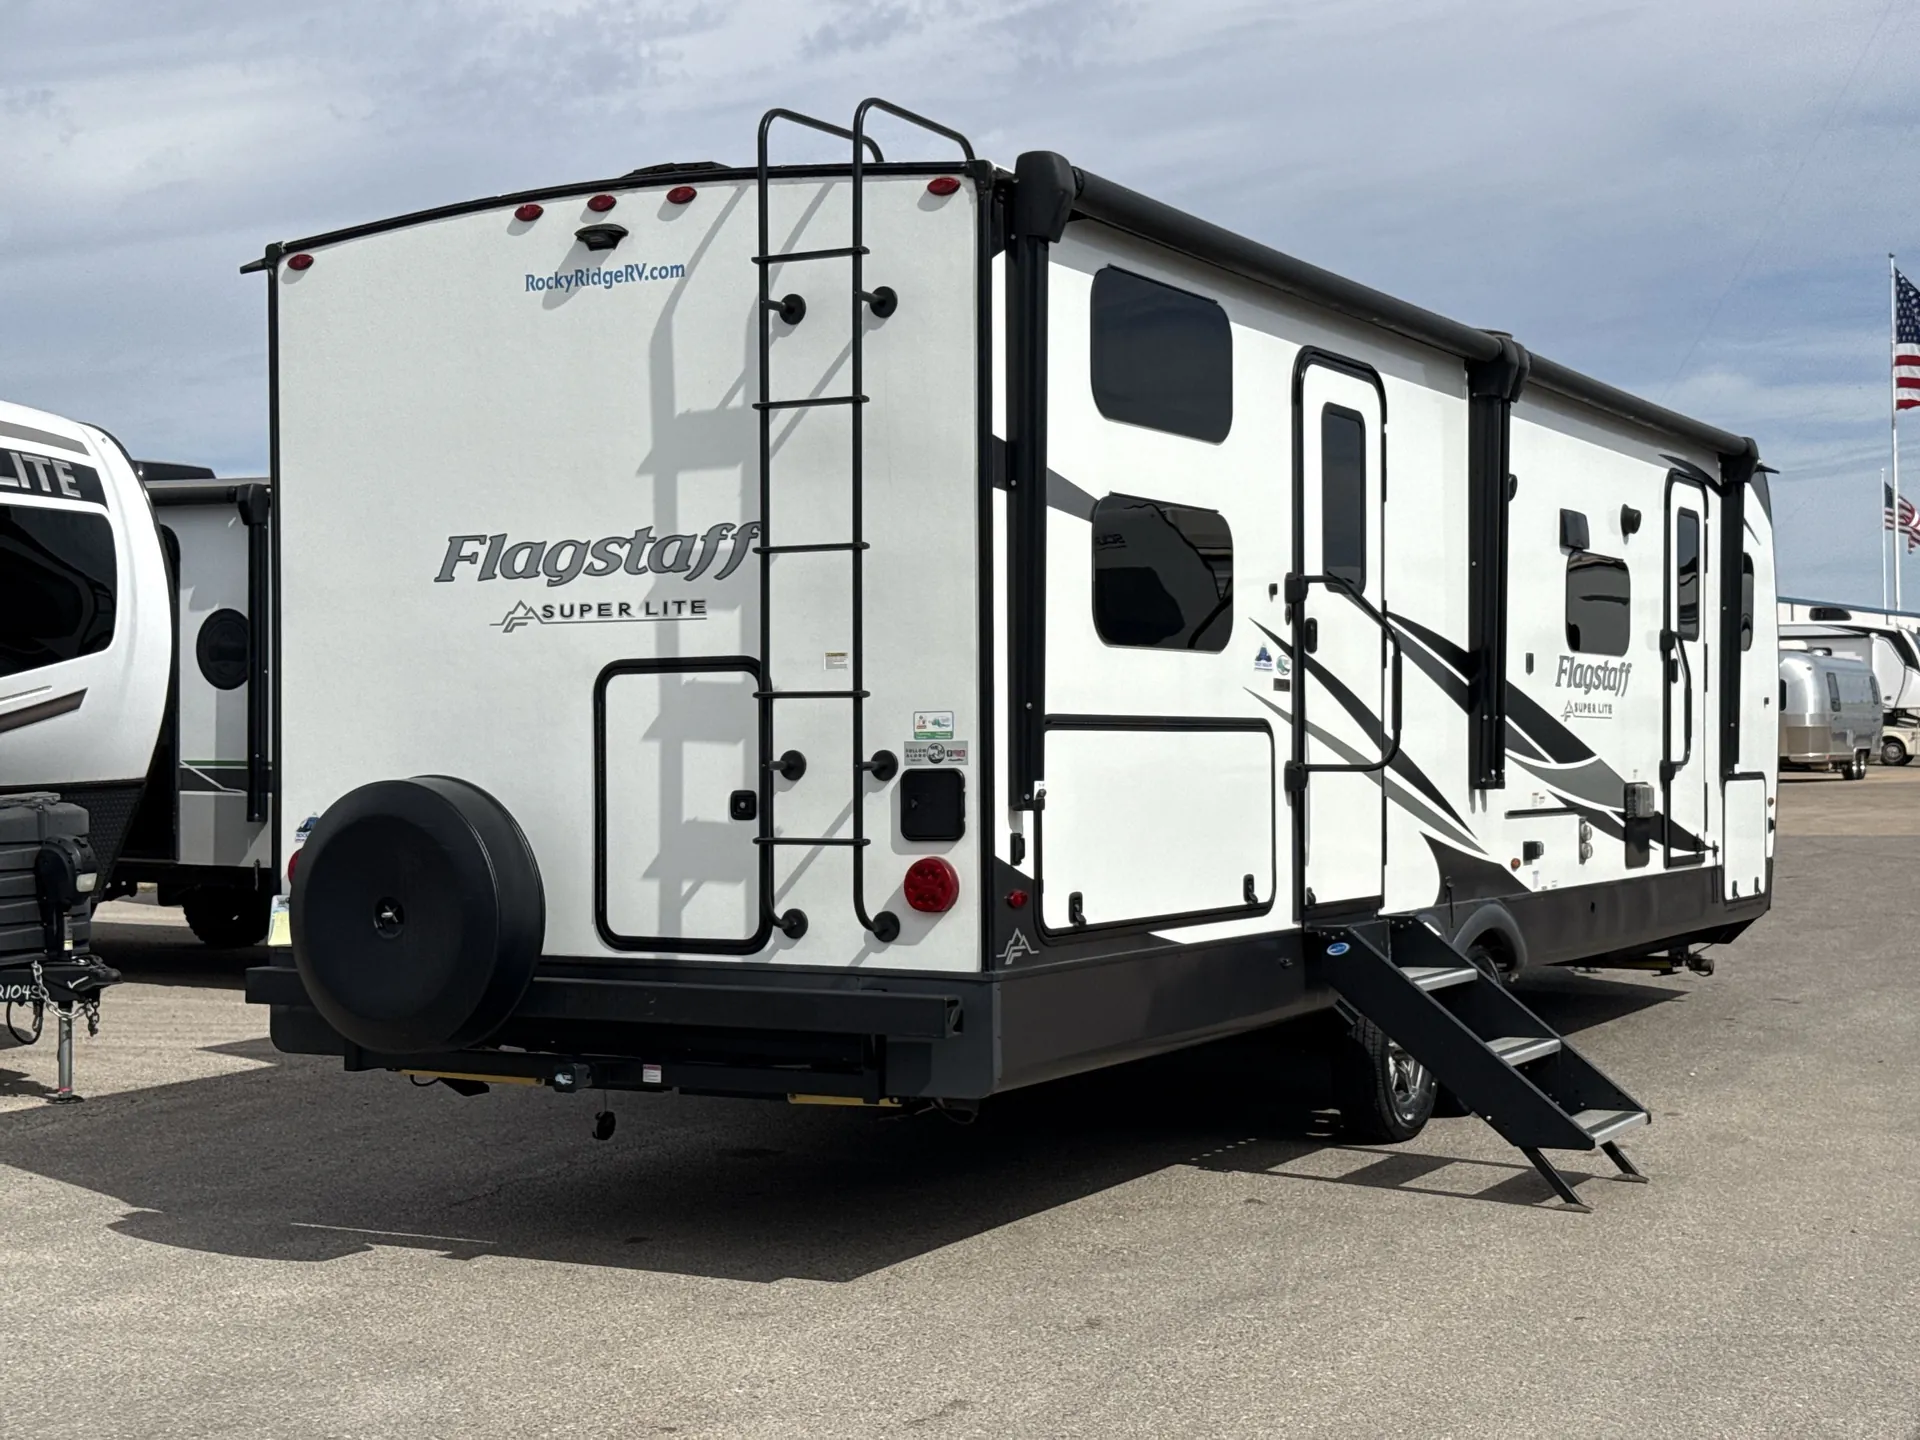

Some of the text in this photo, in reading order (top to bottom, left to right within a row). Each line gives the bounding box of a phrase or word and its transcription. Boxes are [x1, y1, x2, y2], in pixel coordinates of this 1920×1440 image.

[525, 262, 685, 293] RockyRidgeRV.com
[433, 520, 761, 587] Flagstaff
[541, 599, 707, 619] SUPER LITE
[1555, 655, 1632, 697] Flagstaff
[1574, 702, 1612, 714] SUPER LITE
